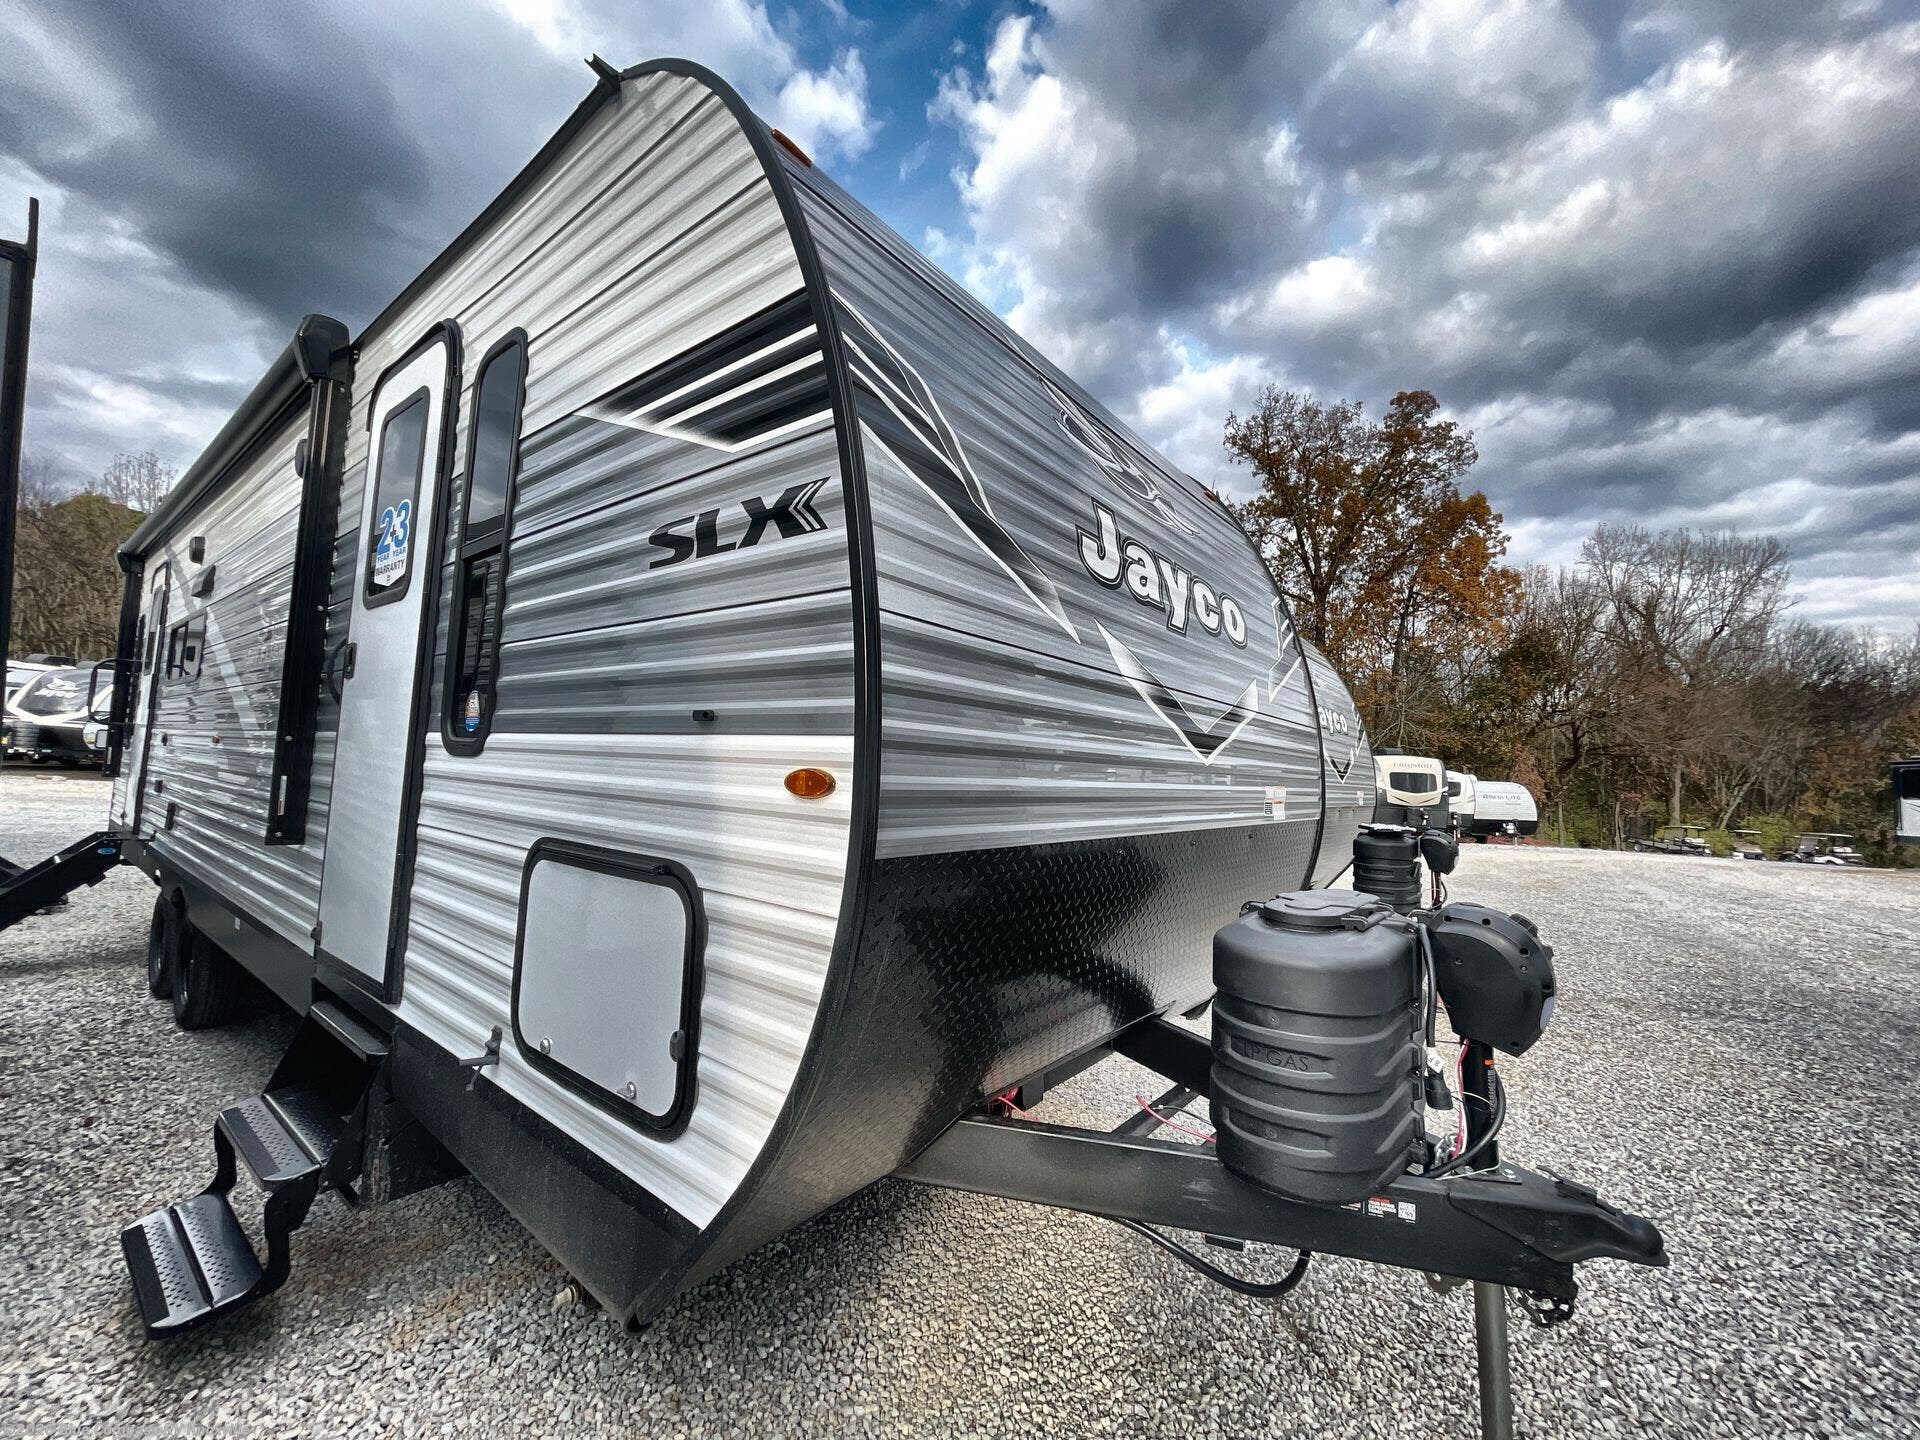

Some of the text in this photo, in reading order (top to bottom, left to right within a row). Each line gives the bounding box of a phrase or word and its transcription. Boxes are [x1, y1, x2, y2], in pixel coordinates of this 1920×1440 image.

[649, 476, 831, 569] SLX
[375, 559, 406, 577] WARRANTY
[1075, 497, 1247, 648] Jayco
[1317, 704, 1348, 736] ayco
[1266, 1049, 1309, 1072] GAS
